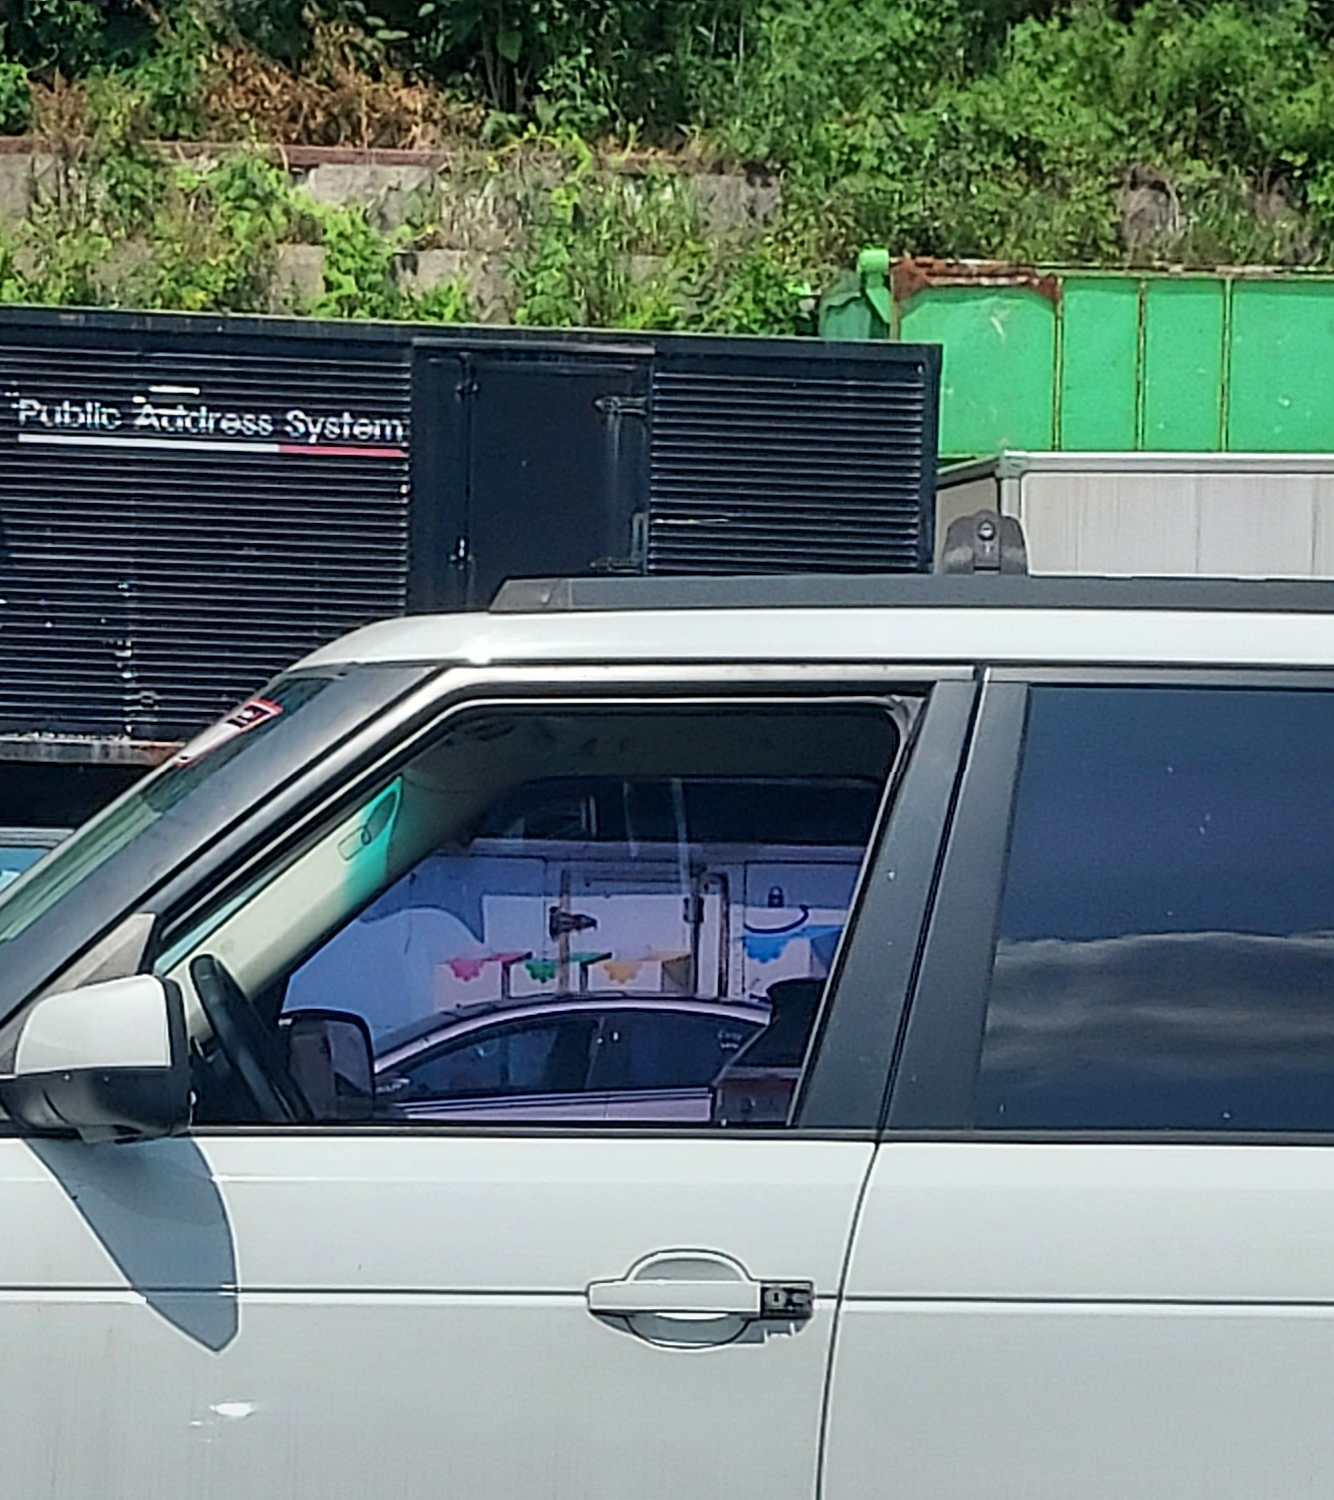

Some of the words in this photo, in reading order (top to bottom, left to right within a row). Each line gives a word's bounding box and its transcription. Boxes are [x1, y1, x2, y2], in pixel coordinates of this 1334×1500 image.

[18, 398, 122, 430] Public
[134, 403, 274, 436] Address
[284, 409, 405, 443] System
